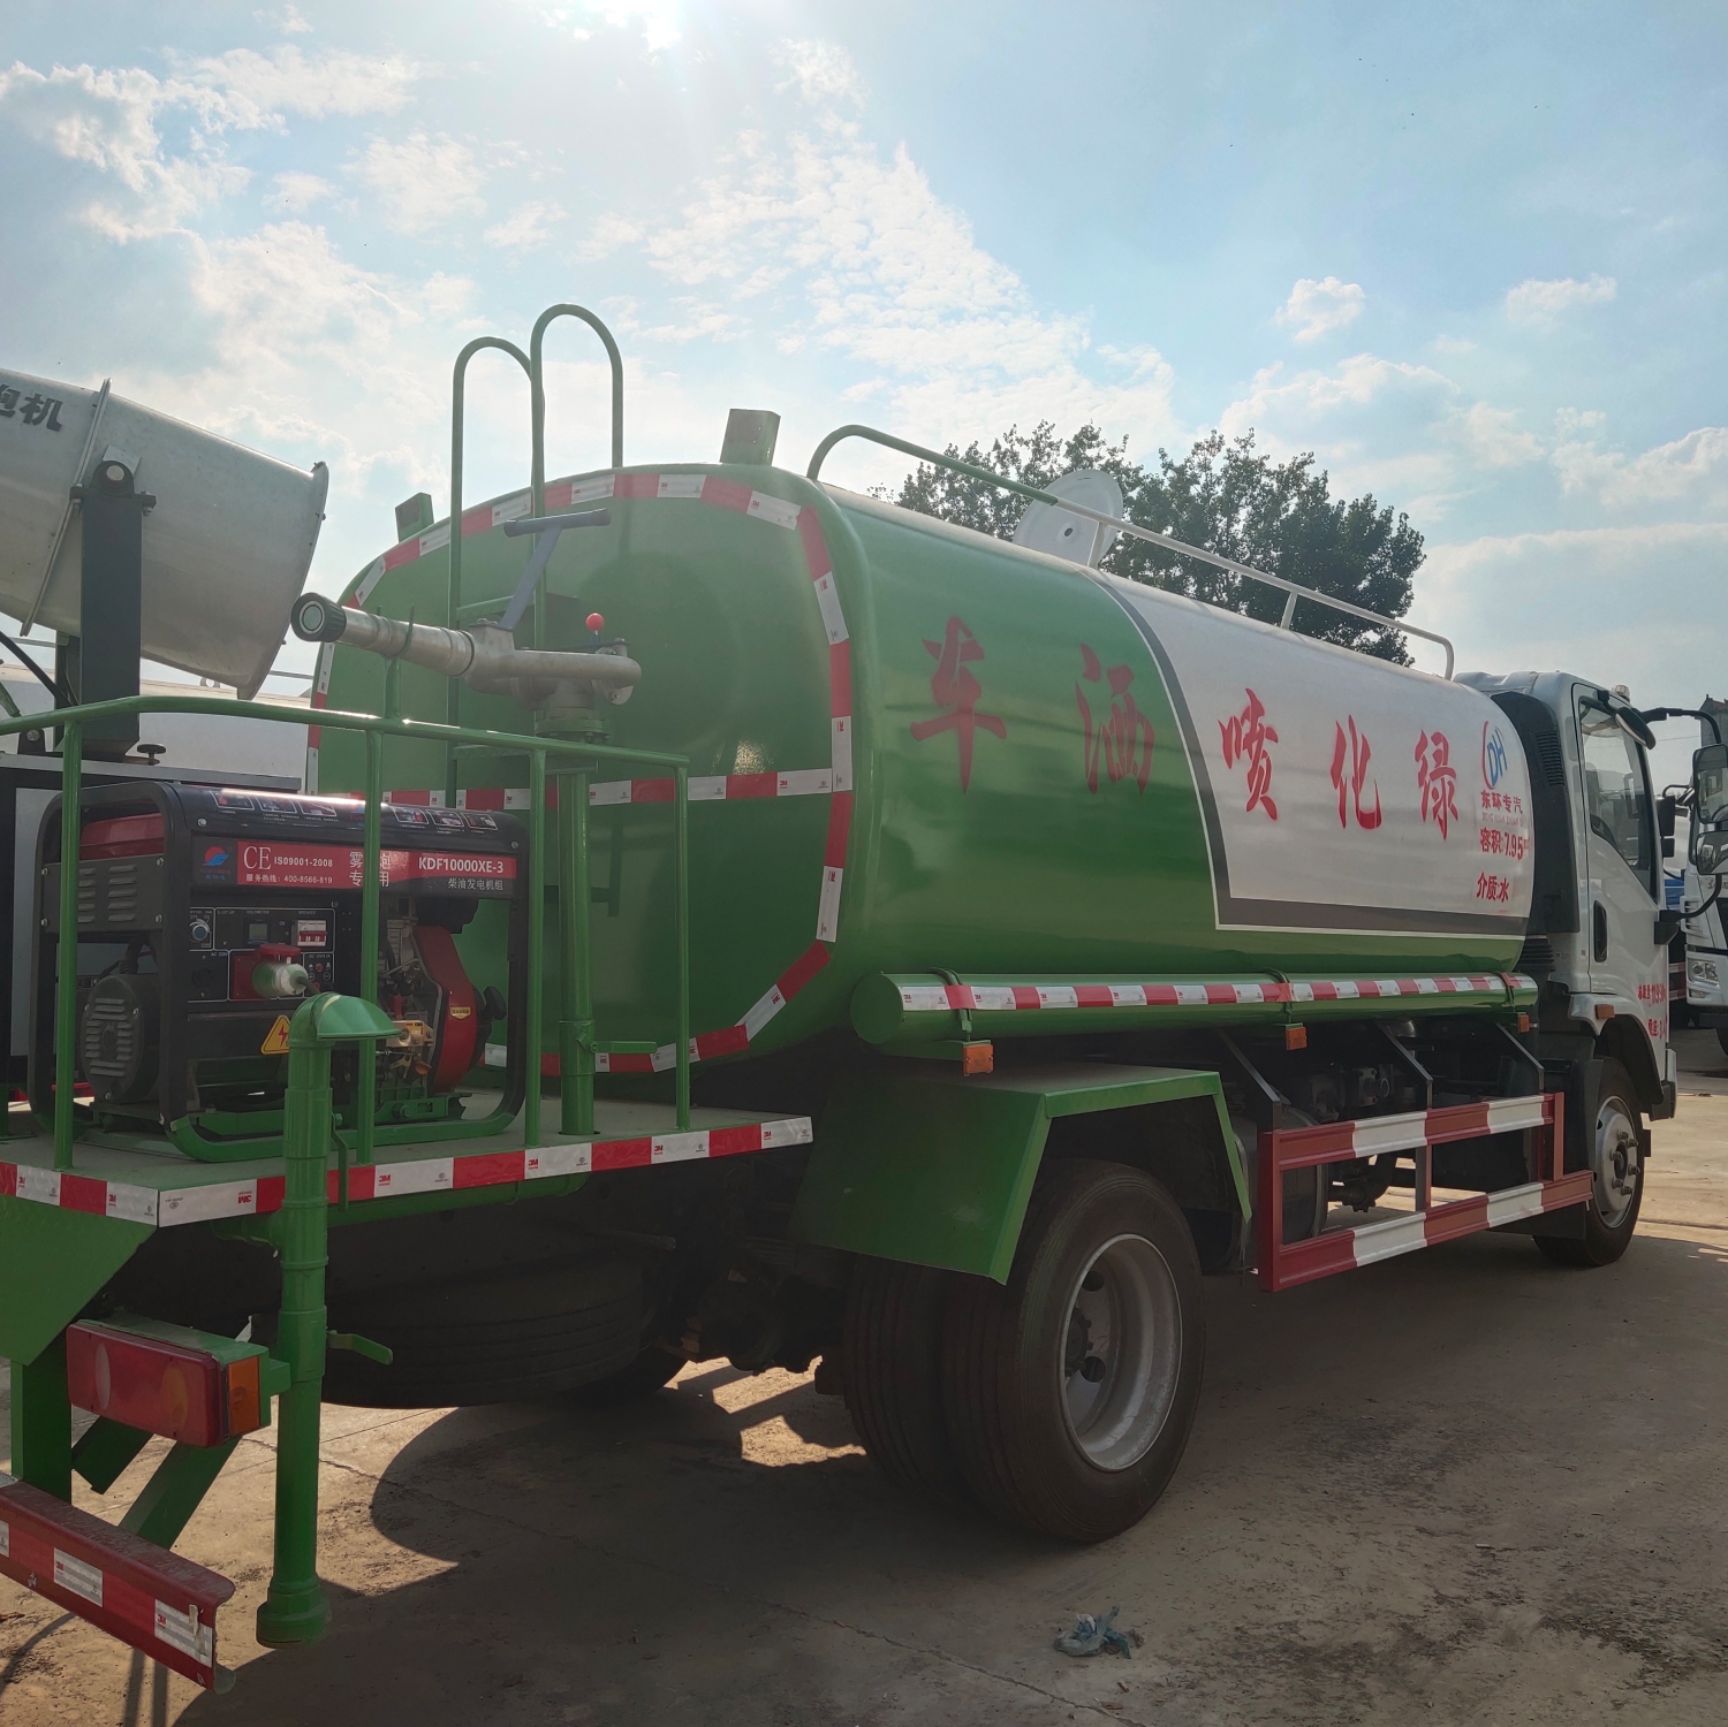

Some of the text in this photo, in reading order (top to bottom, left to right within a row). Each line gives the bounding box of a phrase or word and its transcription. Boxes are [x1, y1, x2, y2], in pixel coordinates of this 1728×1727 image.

[243, 846, 271, 869] CE
[418, 856, 504, 874] KDF10000XE-3
[448, 878, 504, 891] 柴油发电机组
